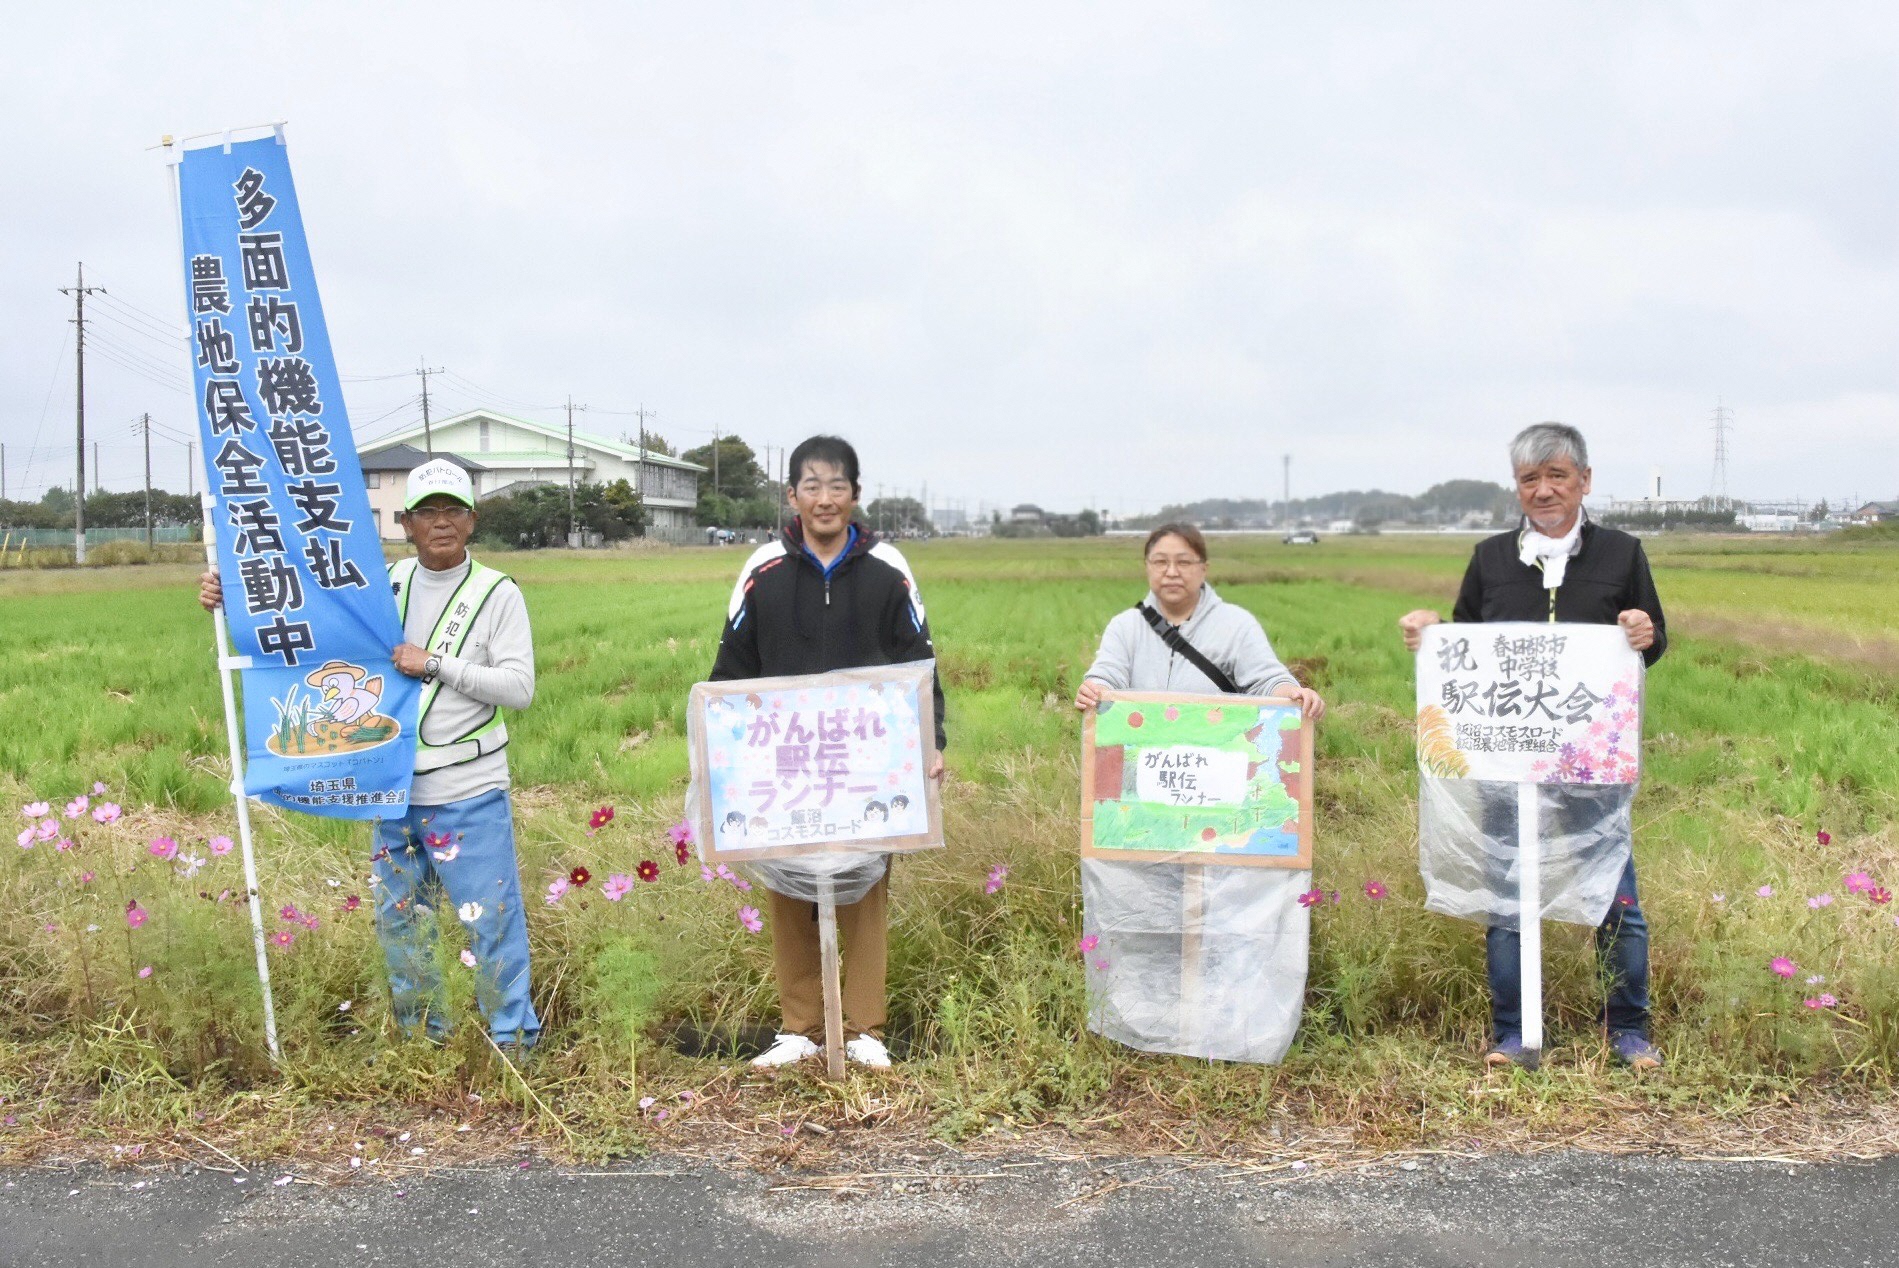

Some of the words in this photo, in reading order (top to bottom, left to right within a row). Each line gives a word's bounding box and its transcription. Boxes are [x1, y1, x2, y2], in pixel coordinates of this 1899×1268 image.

[233, 166, 369, 590] 多面的機能支払
[190, 254, 317, 666] 農地保全活動中
[1437, 636, 1478, 673] 祝
[1492, 633, 1568, 657] 春日部市
[1499, 656, 1561, 681] 中学校
[1441, 679, 1606, 725] 駅伝大会
[747, 707, 887, 748] がんばれ
[775, 743, 850, 779] 駅伝
[1145, 751, 1208, 768] がんばれ
[310, 777, 357, 793] 埼玉県
[749, 776, 878, 814] ランナー
[1158, 771, 1197, 789] 駅伝
[1170, 789, 1221, 805] ランナー
[767, 819, 862, 842] コスモスロード
